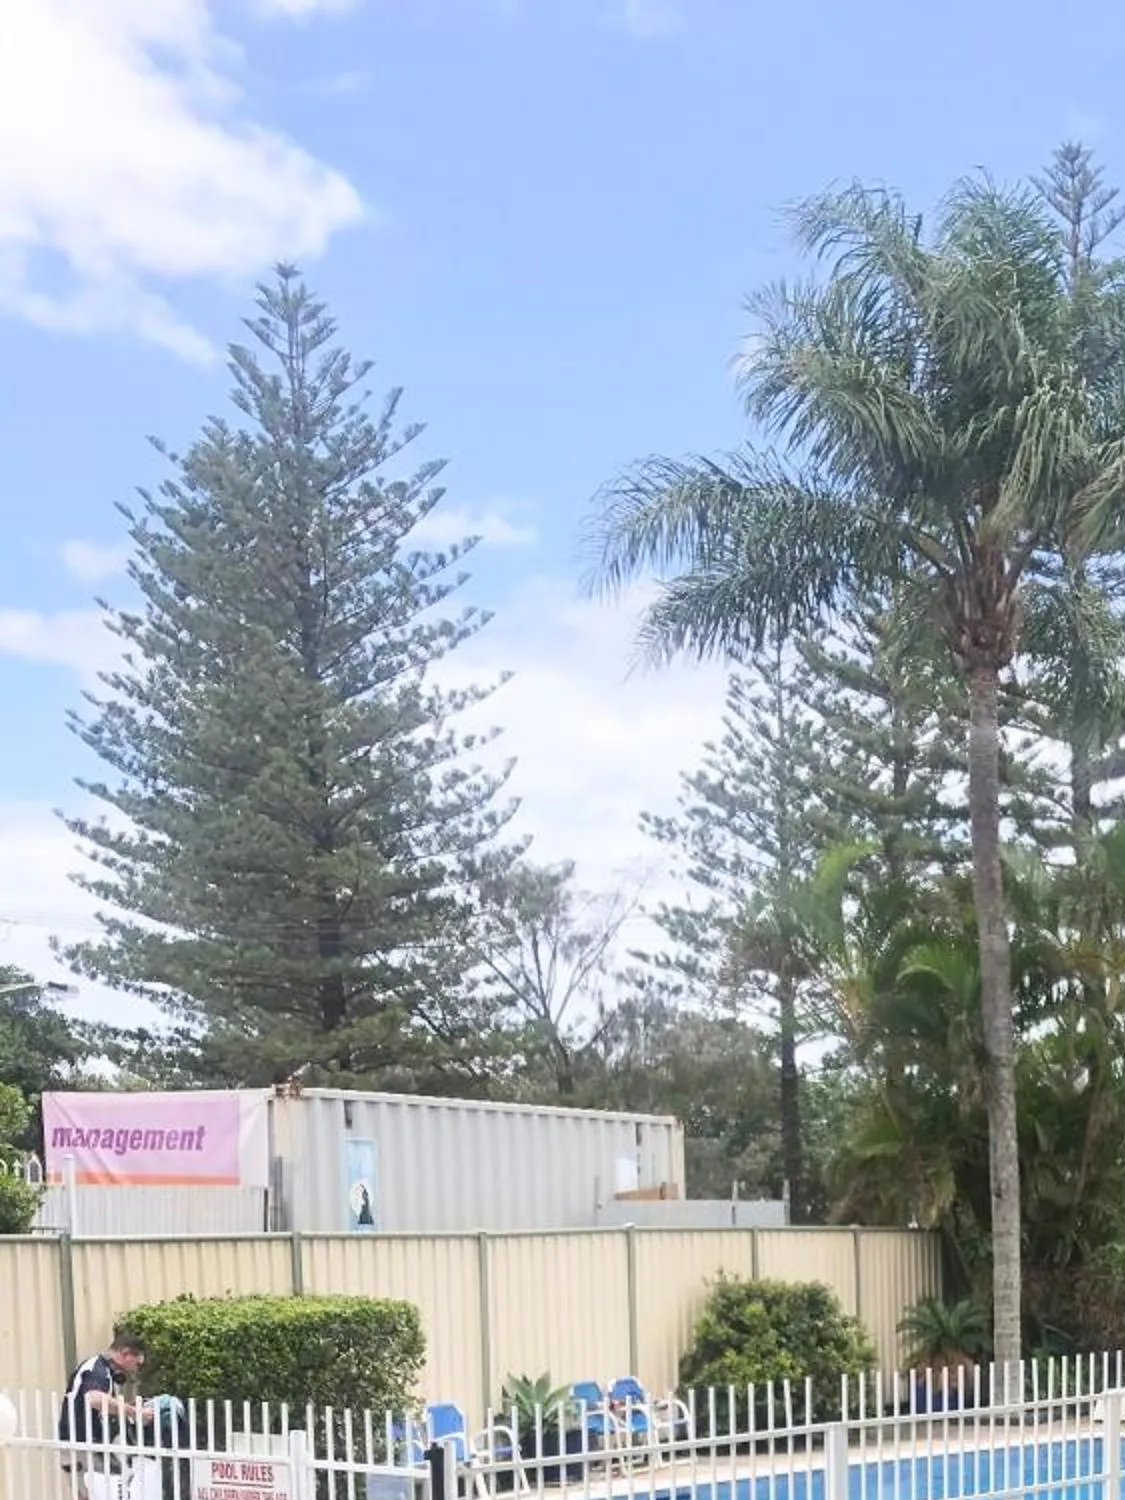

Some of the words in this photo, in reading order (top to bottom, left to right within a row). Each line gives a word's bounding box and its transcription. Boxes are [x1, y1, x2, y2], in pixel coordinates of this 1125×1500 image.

[51, 1125, 206, 1156] management
[211, 1462, 238, 1480] POOL
[241, 1464, 274, 1482] RULES
